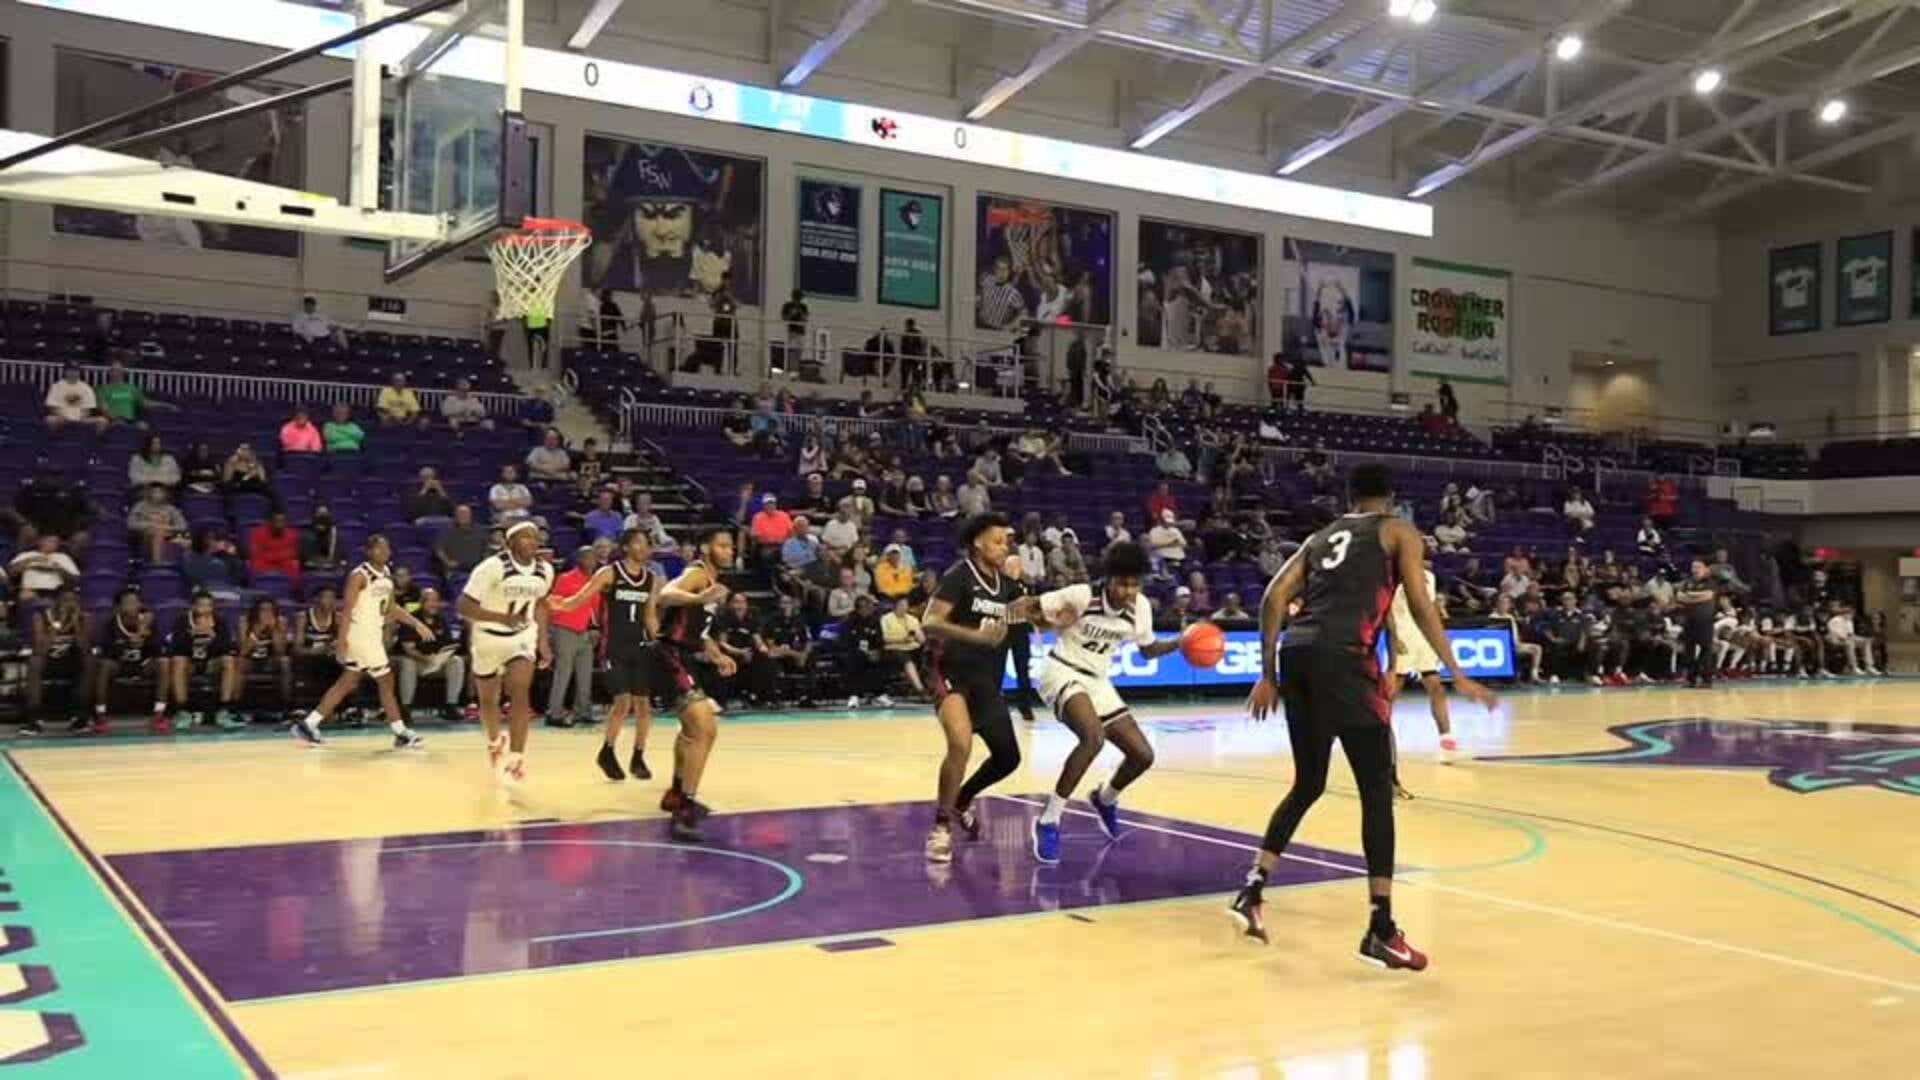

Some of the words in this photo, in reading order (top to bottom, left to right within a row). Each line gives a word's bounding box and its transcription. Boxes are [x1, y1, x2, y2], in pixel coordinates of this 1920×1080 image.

[584, 62, 599, 87] 0
[954, 126, 968, 150] 0
[638, 159, 673, 190] FSW
[1320, 529, 1353, 571] 3
[630, 603, 637, 623] 1
